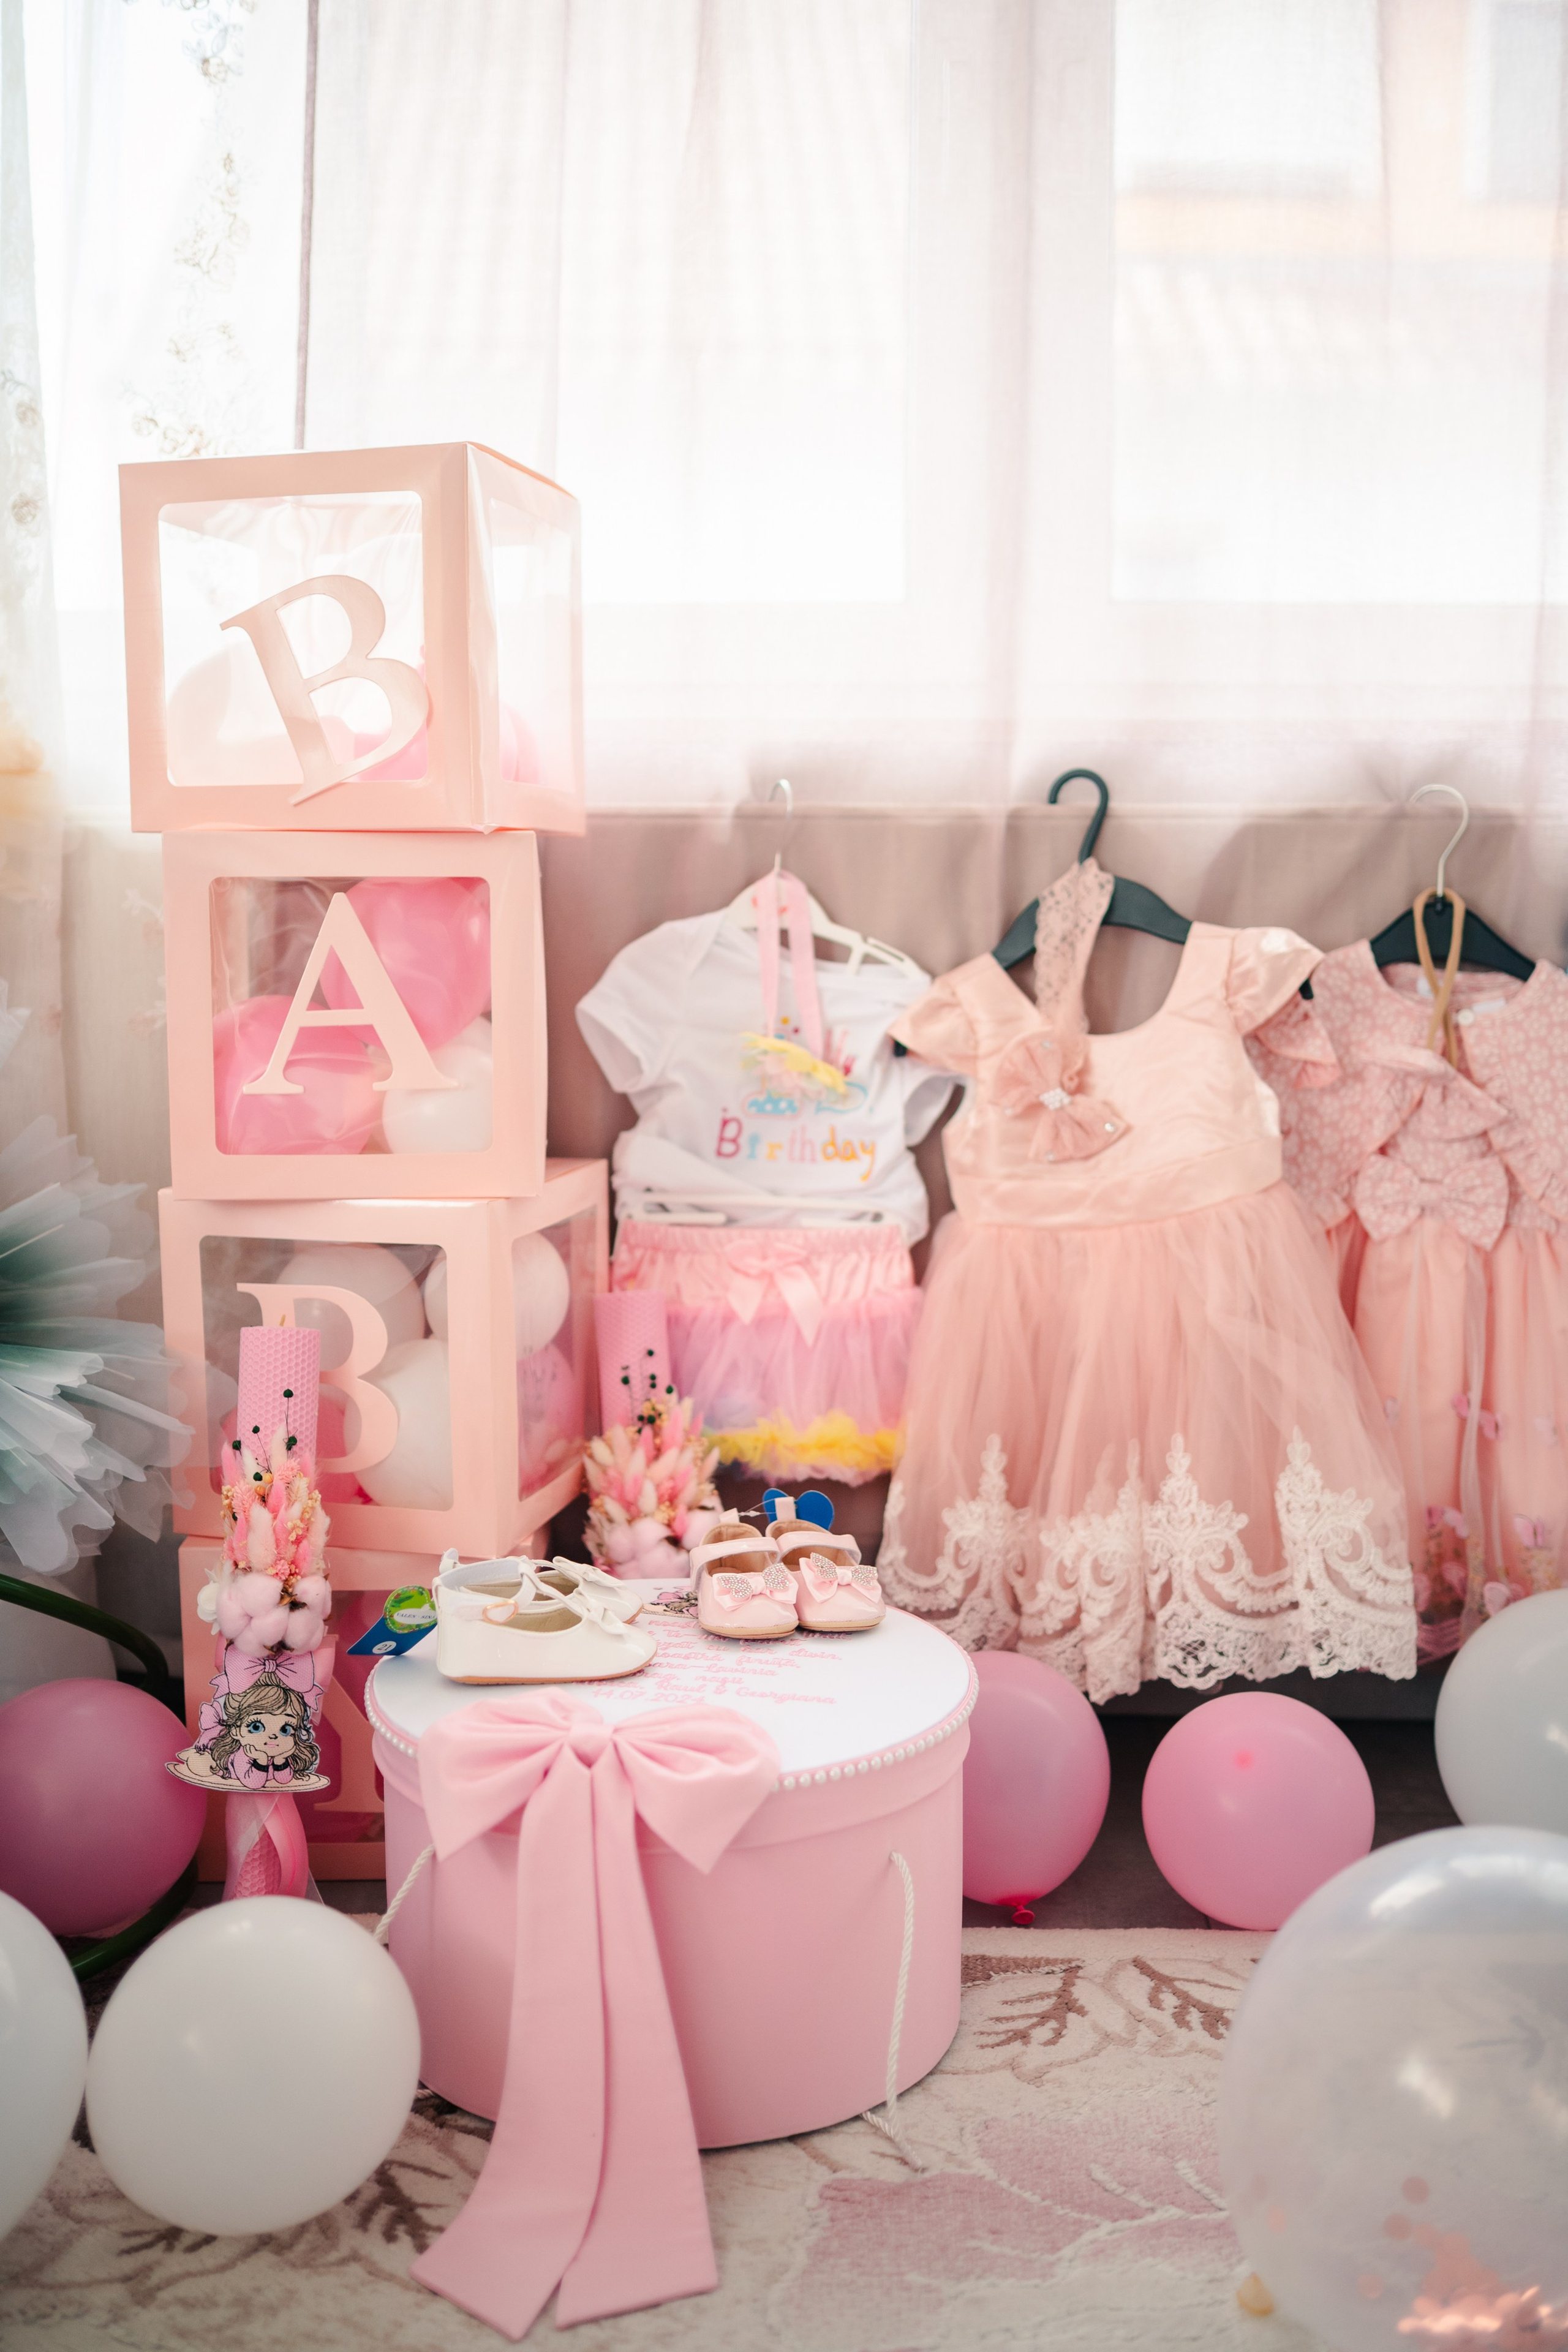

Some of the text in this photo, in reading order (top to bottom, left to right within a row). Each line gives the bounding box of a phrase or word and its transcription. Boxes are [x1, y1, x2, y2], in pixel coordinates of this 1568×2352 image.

[219, 574, 430, 807] B
[243, 892, 459, 1095] A
[715, 1117, 876, 1182] Birthday
[236, 1283, 399, 1474] B
[736, 1687, 836, 1704] Georgiana
